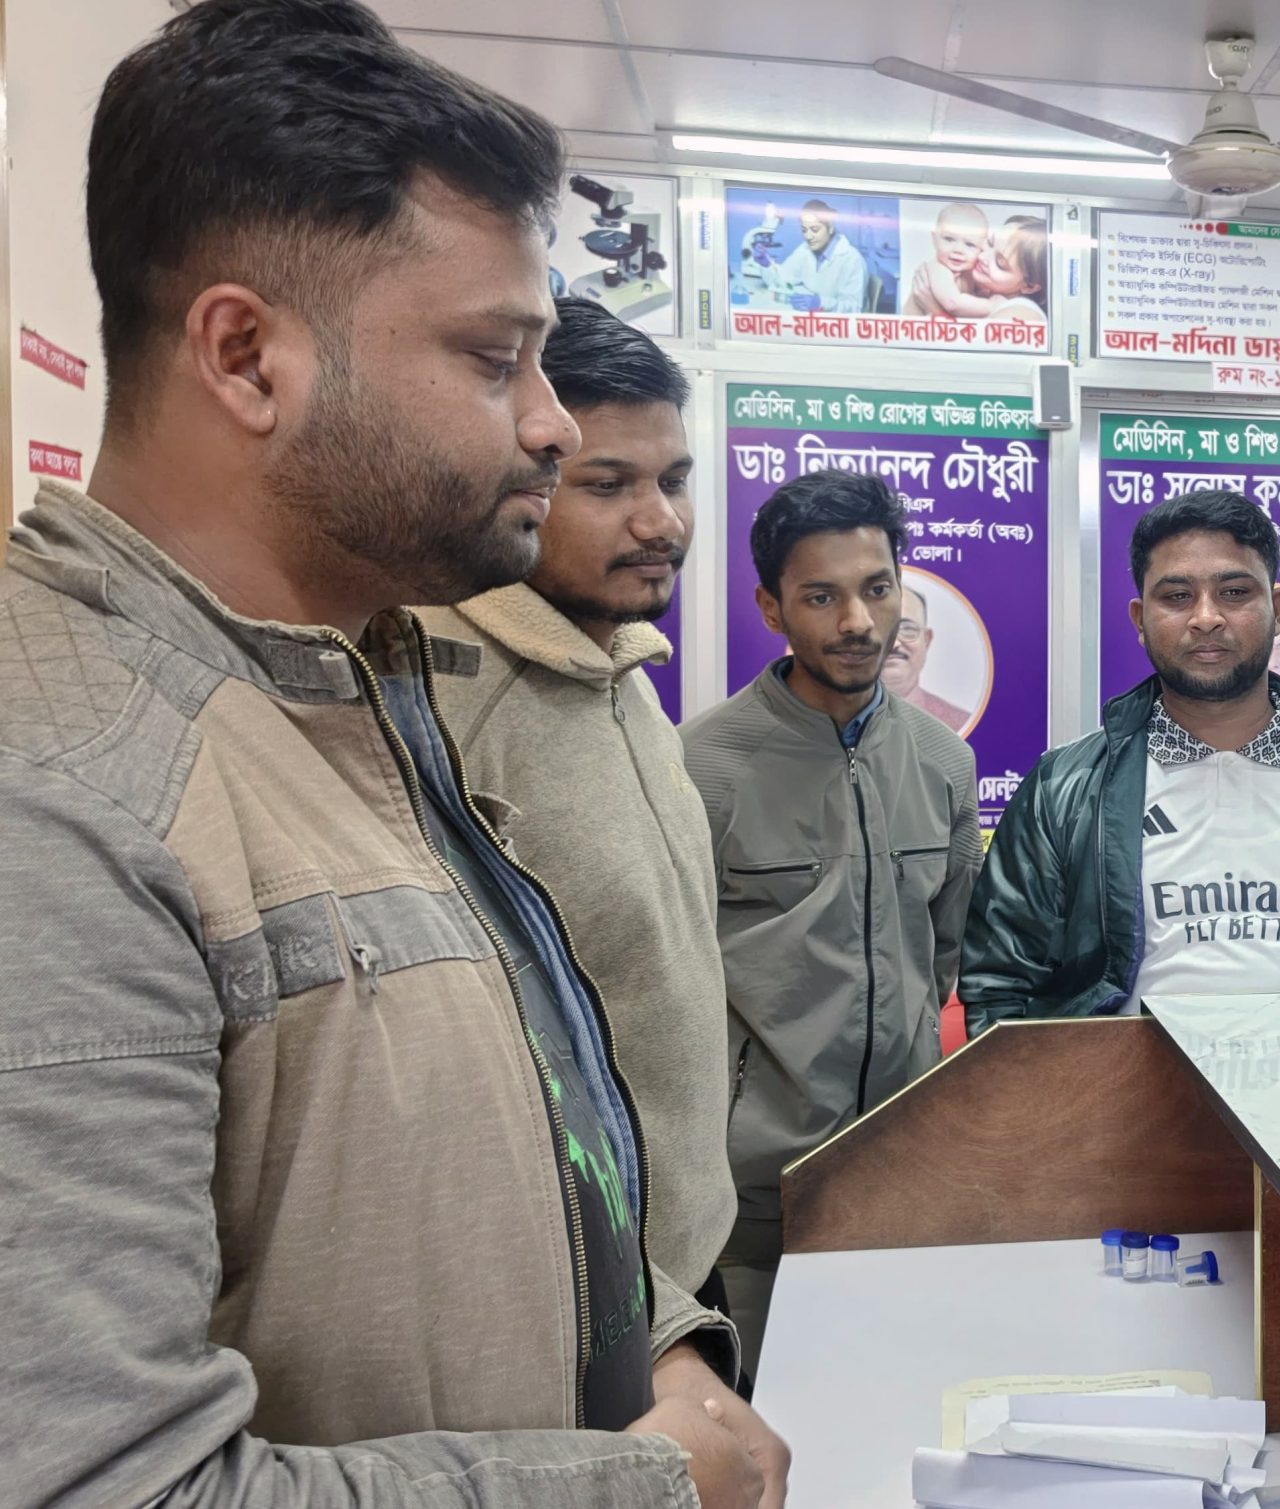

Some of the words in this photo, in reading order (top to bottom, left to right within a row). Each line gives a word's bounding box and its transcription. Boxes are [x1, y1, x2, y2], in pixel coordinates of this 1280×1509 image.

[1183, 252, 1217, 266] (ECG)
[1179, 268, 1216, 281] (X-ray)
[734, 308, 849, 339] আল-মদিনা
[857, 313, 977, 344] ডায়াগনস্টিক
[984, 317, 1046, 345] সেন্টার
[1104, 327, 1237, 357] আল-মদিনা
[1217, 367, 1242, 385] রুম
[734, 390, 802, 424] মেডিসিন,
[807, 397, 822, 422] মা
[829, 401, 841, 420] ও
[846, 394, 875, 424] শিশু
[879, 402, 927, 426] রোগের
[930, 399, 976, 425] অভিজ্ঞ
[1113, 419, 1194, 459] মেডিসিন,
[1199, 429, 1219, 456] মা
[1225, 433, 1240, 453] ও
[1244, 424, 1278, 457] শিশু
[732, 443, 786, 484] ডাঃ
[942, 439, 1039, 502] চৌধুরী
[1106, 471, 1154, 504] ডাঃ
[929, 518, 983, 539] কর্মকর্তা
[1184, 917, 1221, 944] FLY
